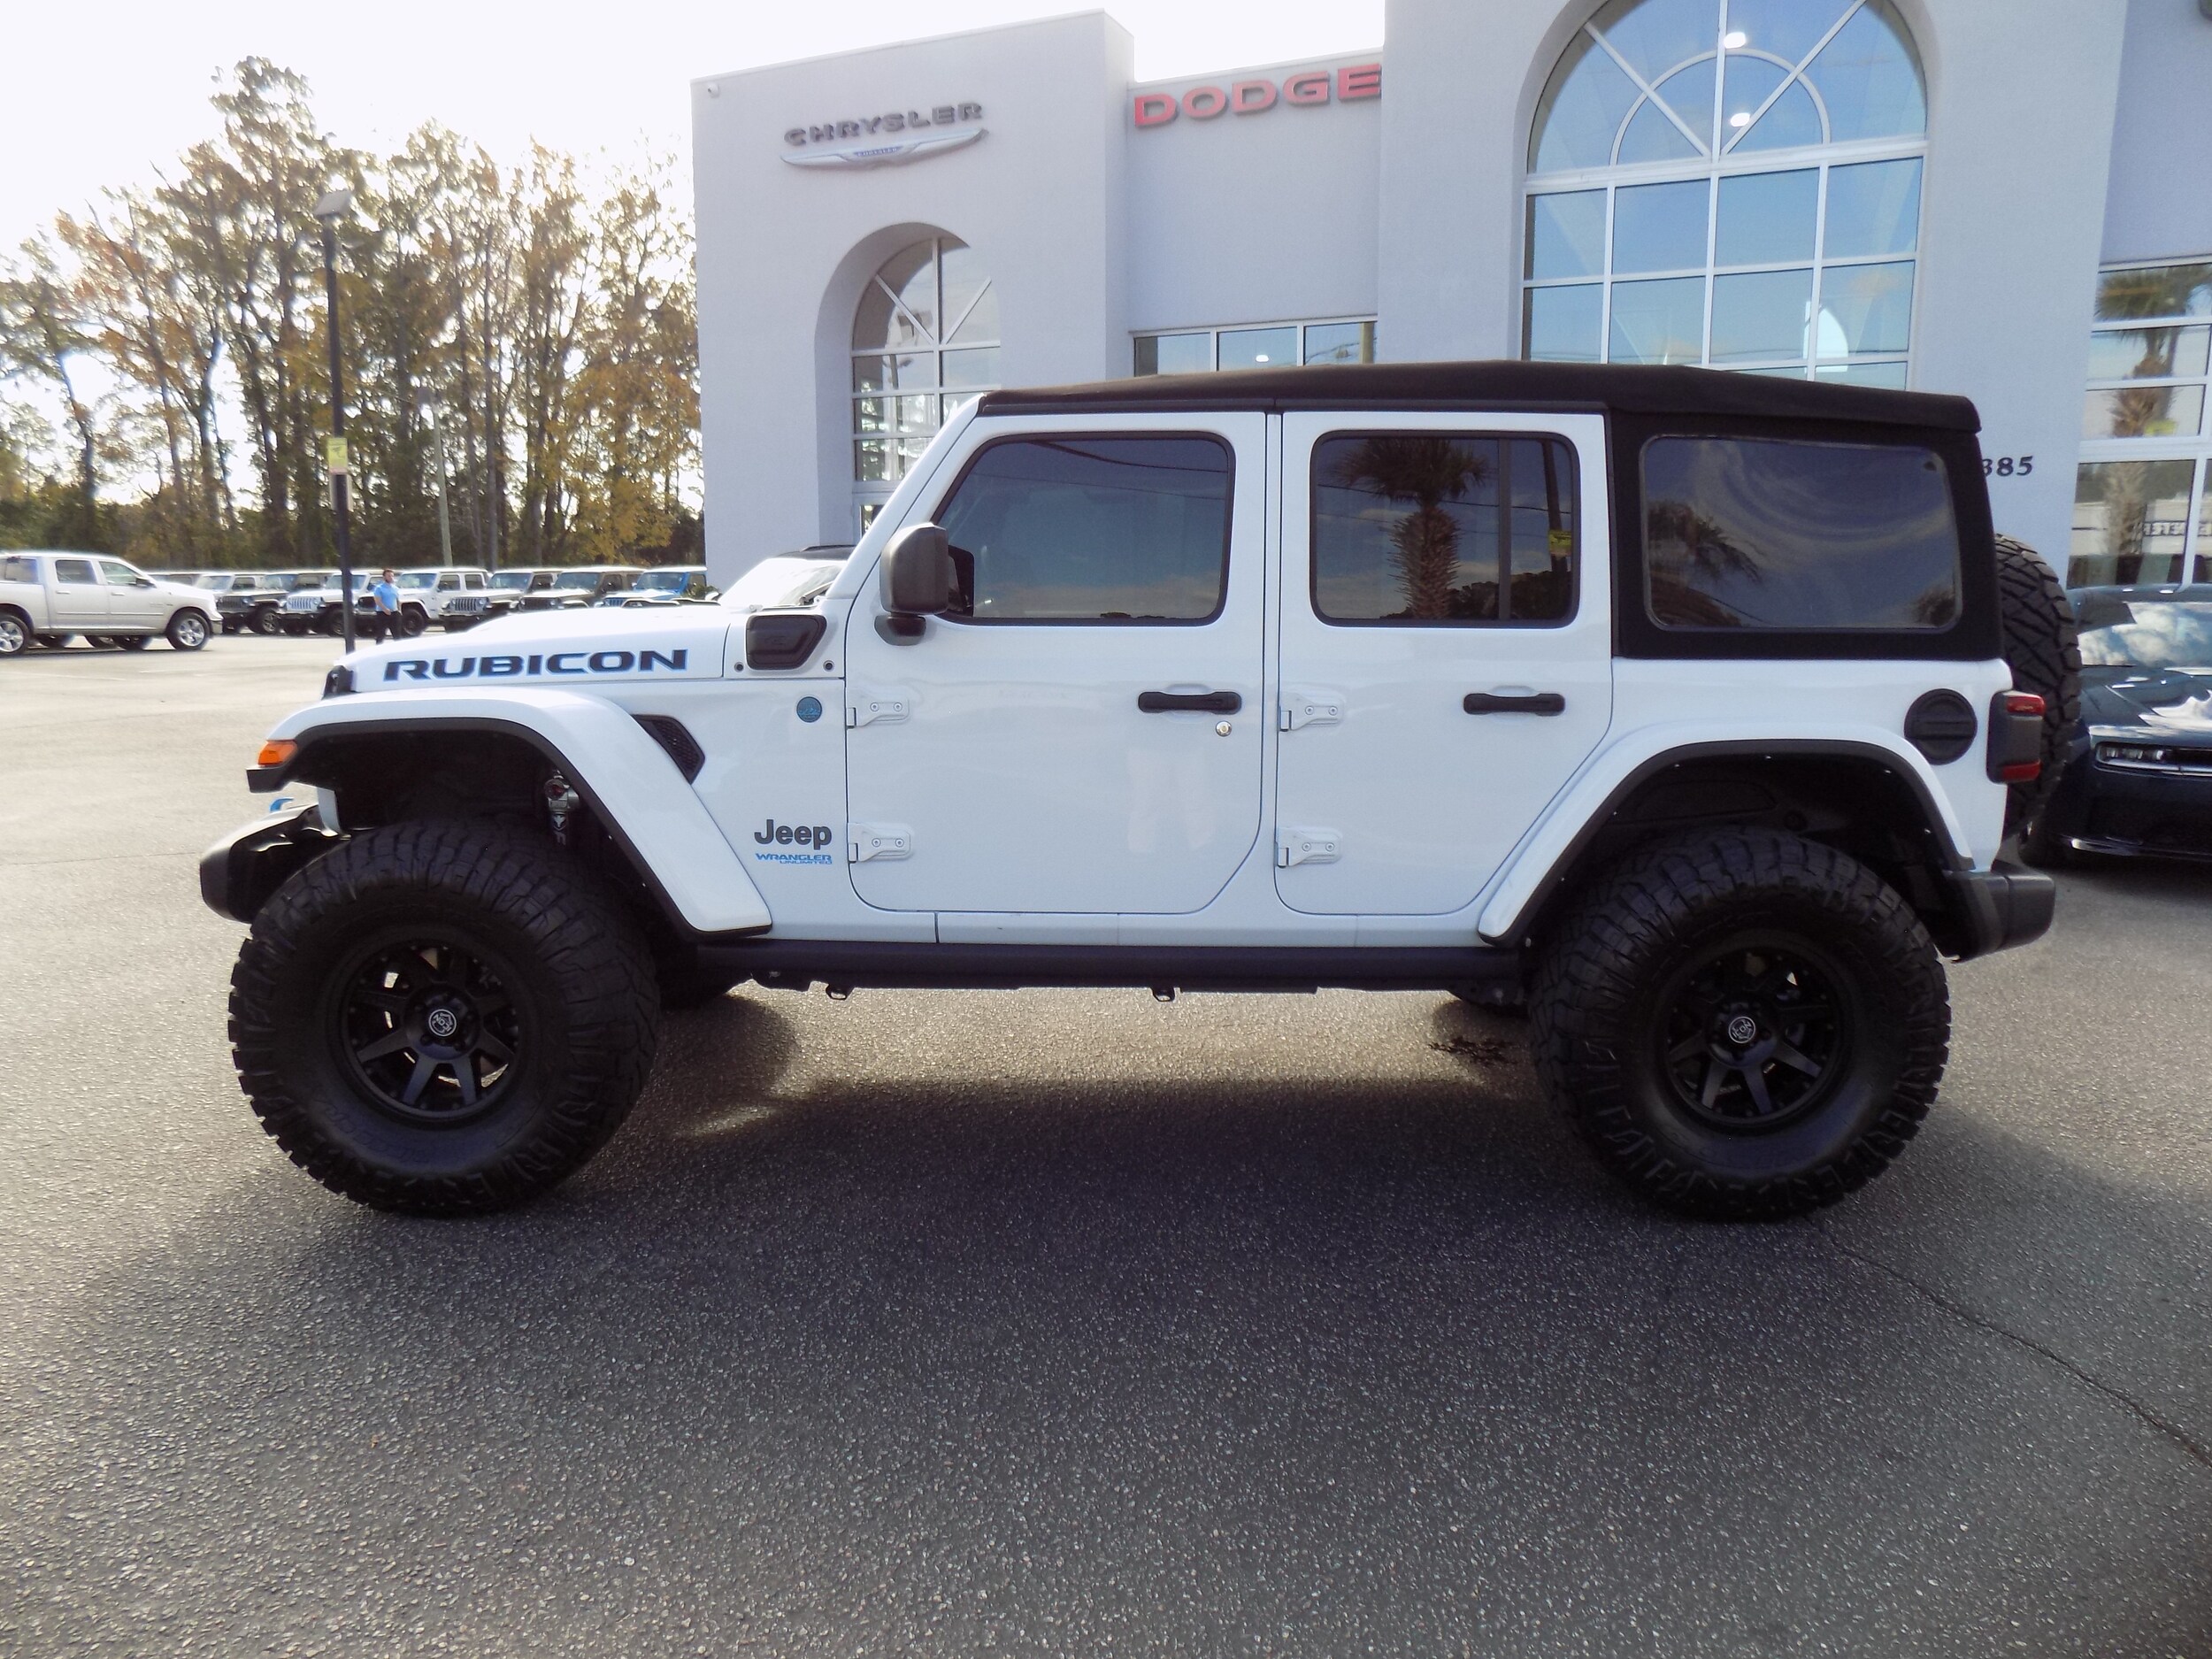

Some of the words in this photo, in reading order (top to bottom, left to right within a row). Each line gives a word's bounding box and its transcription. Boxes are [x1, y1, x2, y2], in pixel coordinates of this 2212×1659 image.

[1134, 63, 1382, 128] DODGE
[784, 102, 983, 146] CHRYSLER
[383, 649, 688, 682] RUBICON
[754, 818, 832, 850] Jeep
